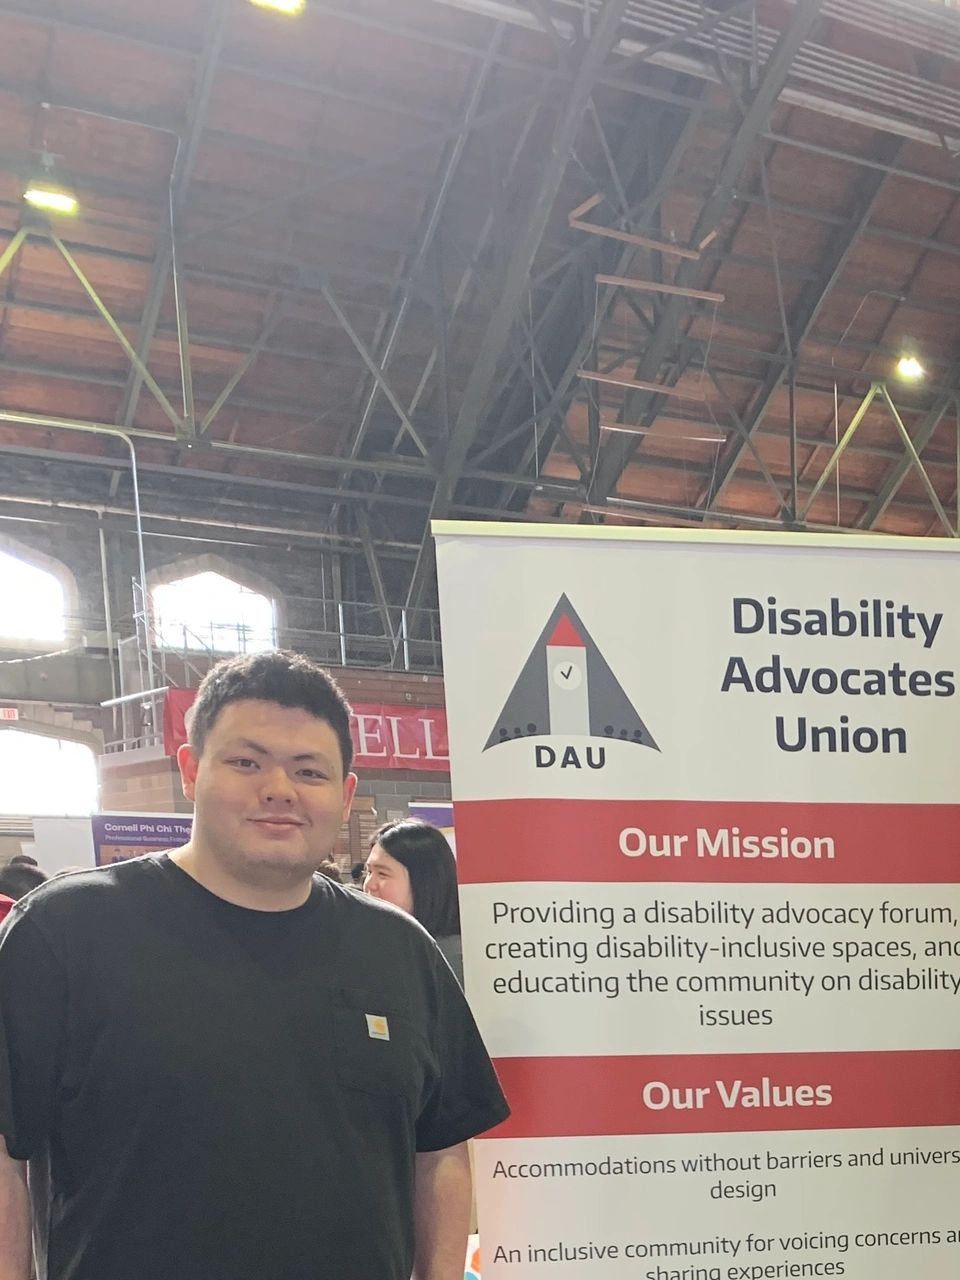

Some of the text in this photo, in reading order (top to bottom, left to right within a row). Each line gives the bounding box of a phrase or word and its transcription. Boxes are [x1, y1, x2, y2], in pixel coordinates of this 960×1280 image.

[733, 596, 944, 649] Disability
[720, 654, 956, 697] Advocates
[775, 715, 907, 754] Union
[535, 745, 606, 770] DAU
[104, 823, 193, 834] Cornell Phi Chi The
[619, 826, 835, 859] Our Mission
[493, 899, 958, 930] Providing a disability advocacy forum,
[485, 935, 588, 965] creating
[596, 934, 825, 964] disability-inclusive
[832, 941, 917, 963] spaces,
[493, 969, 620, 999] educating
[625, 969, 669, 993] the
[676, 969, 815, 997] community
[821, 975, 851, 991] on
[699, 1004, 773, 1027] issues
[642, 1077, 833, 1111] Our Values
[492, 1155, 677, 1179] Accommodations
[681, 1152, 762, 1173] without
[766, 1150, 843, 1170] barriers
[847, 1147, 884, 1167] and
[710, 1179, 777, 1203] design
[493, 1245, 521, 1264] An
[527, 1241, 619, 1263] inclusive
[624, 1235, 742, 1259] community
[745, 1233, 775, 1253] for
[778, 1231, 849, 1253] voicing
[854, 1230, 941, 1247] concerns
